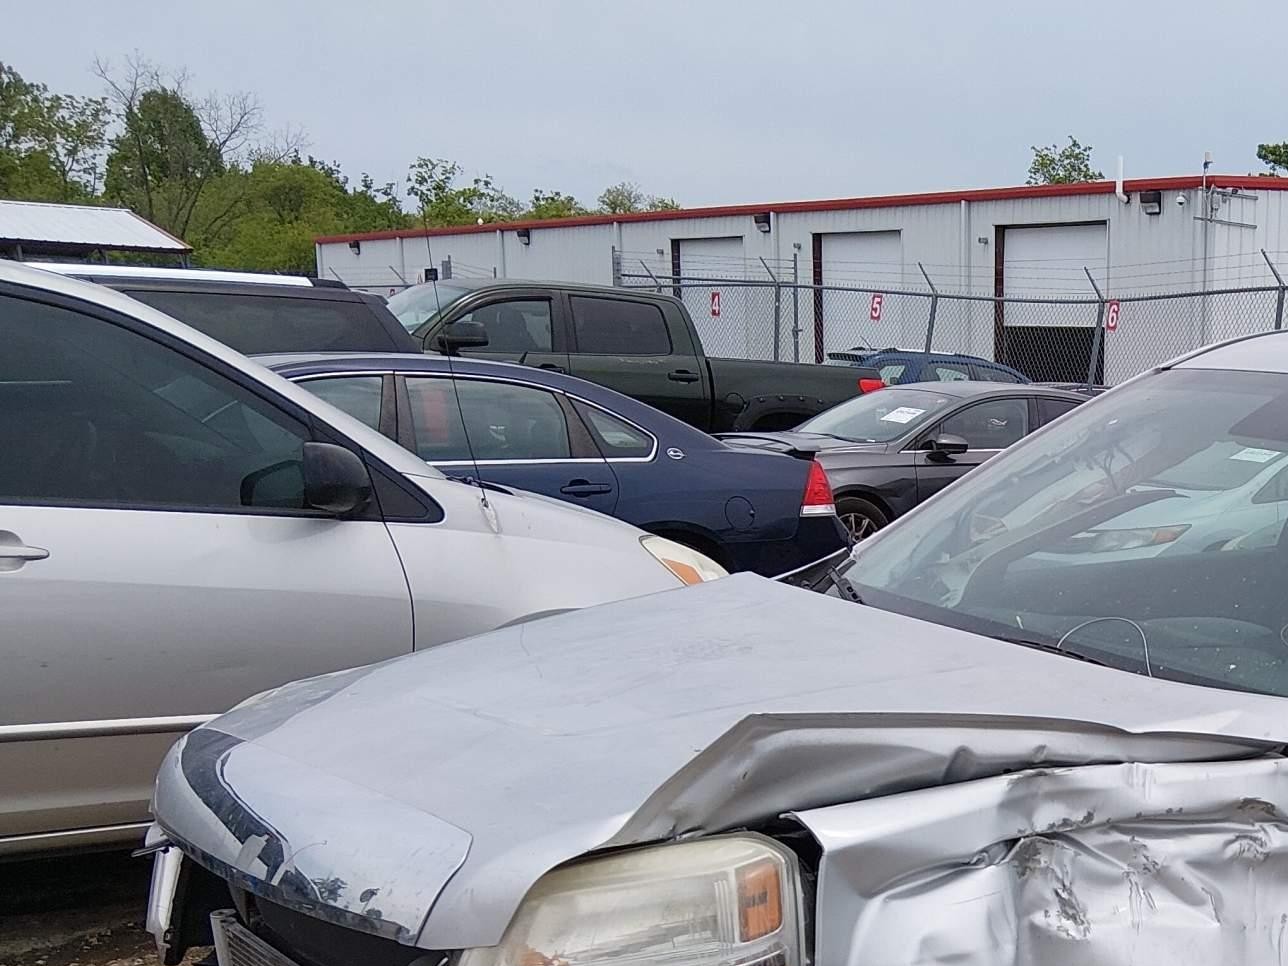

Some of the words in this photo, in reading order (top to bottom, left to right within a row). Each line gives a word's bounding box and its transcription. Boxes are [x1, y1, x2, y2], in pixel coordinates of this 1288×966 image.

[712, 295, 719, 314] 4
[872, 297, 881, 317] 5
[1108, 304, 1118, 328] 6
